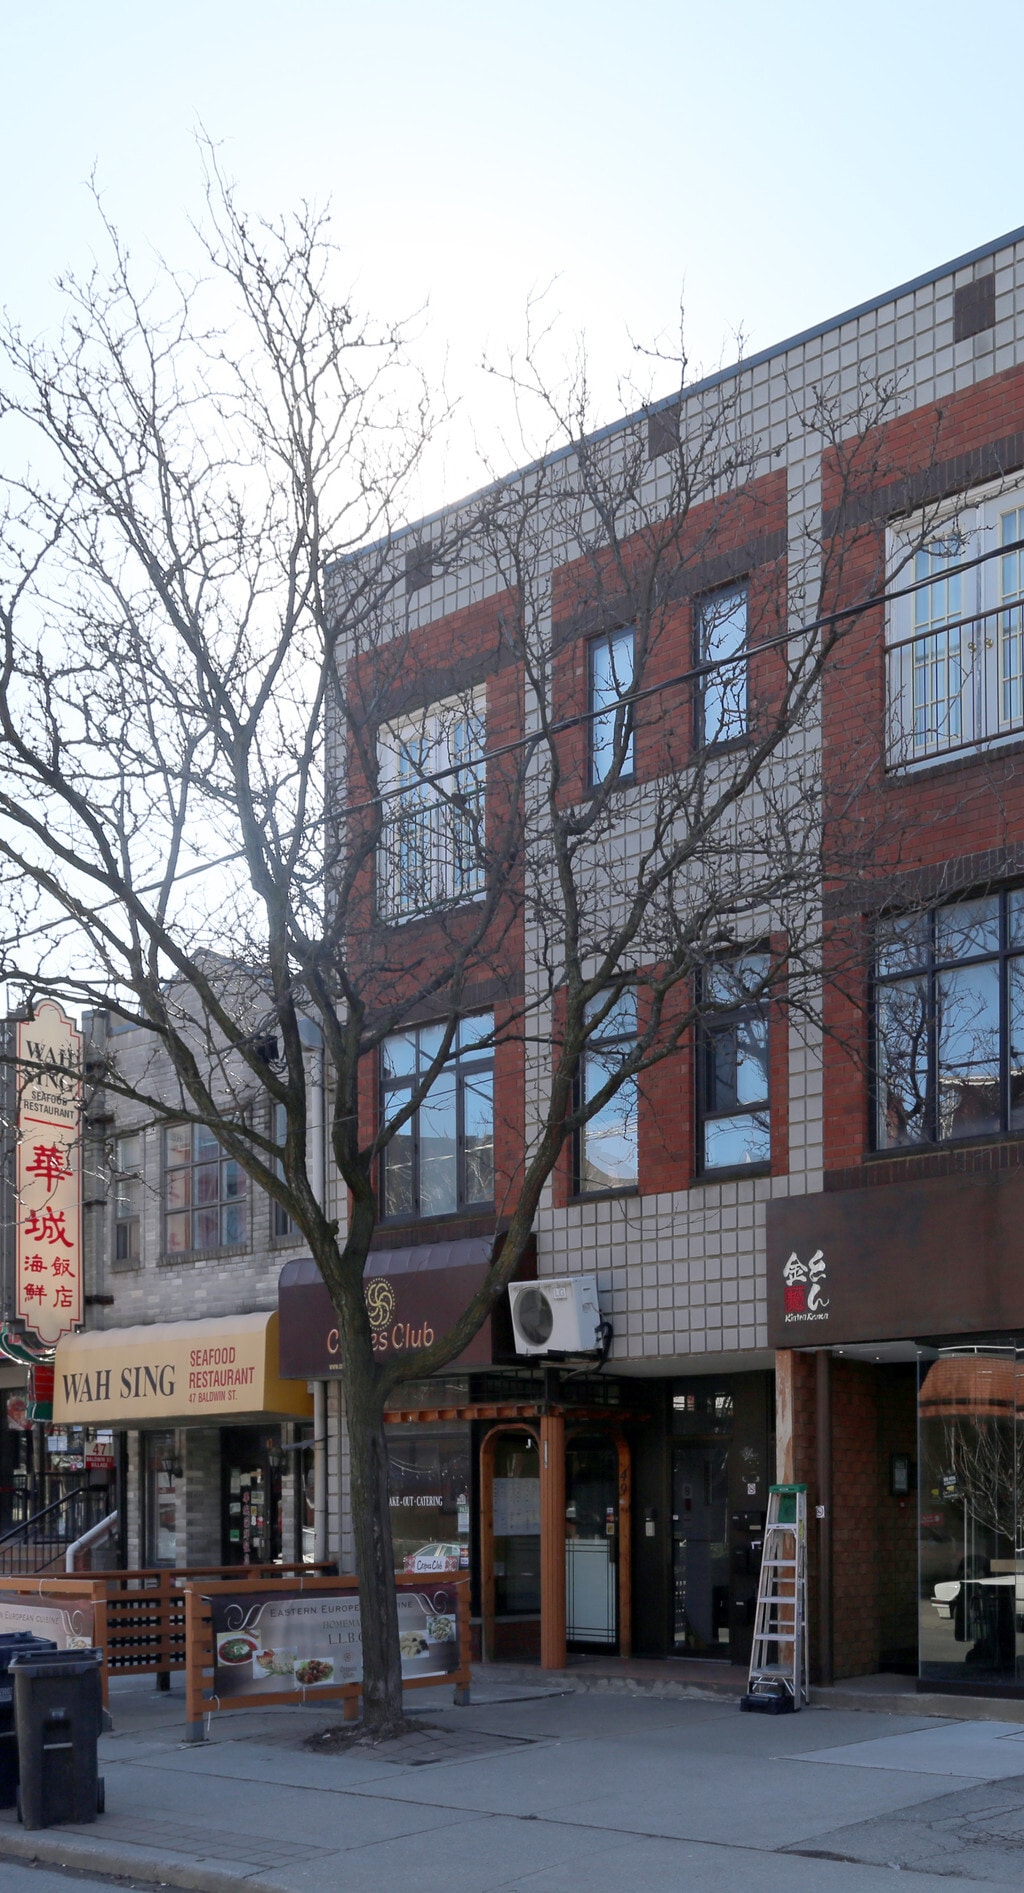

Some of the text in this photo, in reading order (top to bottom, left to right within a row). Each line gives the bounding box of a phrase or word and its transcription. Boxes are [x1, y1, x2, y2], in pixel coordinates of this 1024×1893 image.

[31, 1090, 68, 1107] SEAFOOD
[23, 1100, 75, 1119] RESTAURANT
[391, 1321, 435, 1350] Club
[190, 1346, 236, 1367] SEAFOOD
[62, 1364, 176, 1405] WAH SING
[189, 1366, 255, 1389] RESTAURANT
[188, 1389, 238, 1404] 47 BALDWIN ST.
[93, 1443, 107, 1455] 47
[4, 1610, 35, 1622] EUROPEAN
[36, 1615, 60, 1625] CUISINE
[270, 1604, 360, 1618] EASTERN EUROPE
[322, 1619, 361, 1630] HOMEMA
